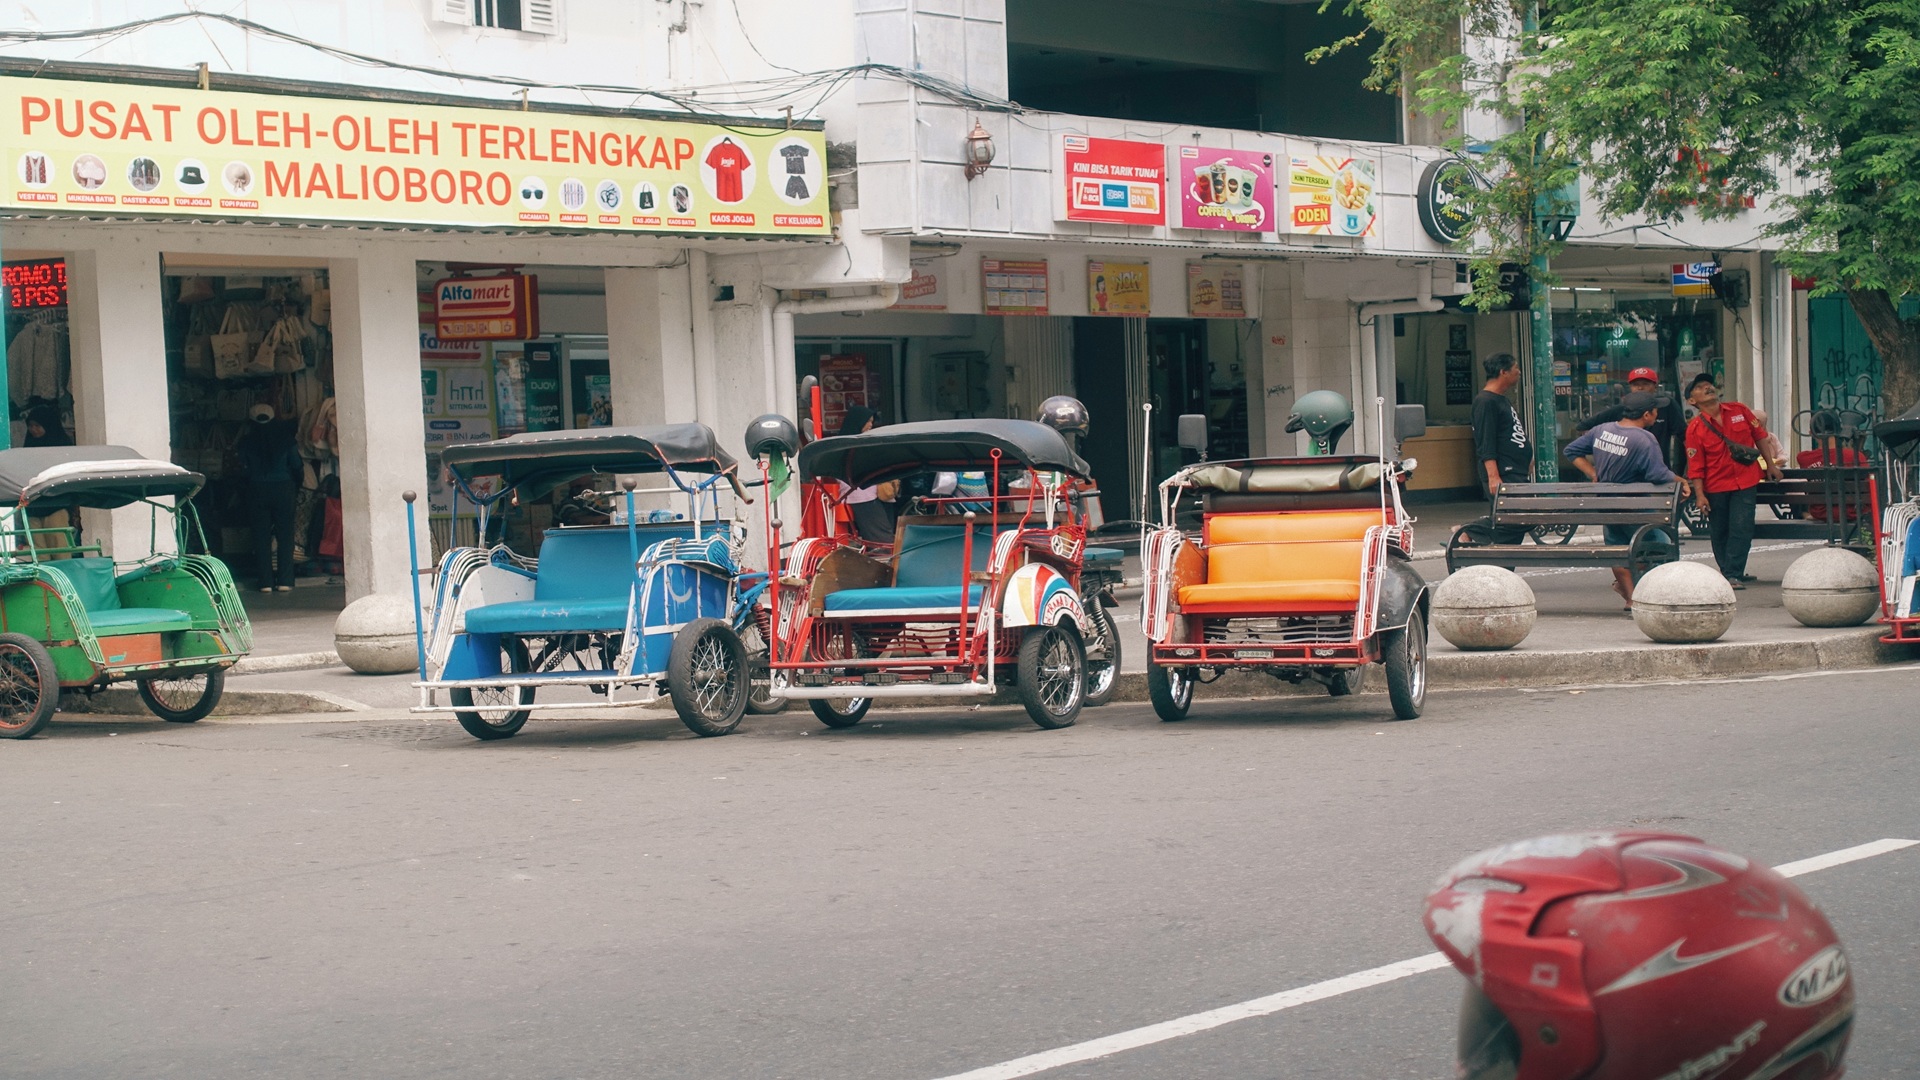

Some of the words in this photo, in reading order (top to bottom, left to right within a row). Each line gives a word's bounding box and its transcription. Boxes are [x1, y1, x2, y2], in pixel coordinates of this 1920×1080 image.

[21, 96, 181, 142] PUSAT
[197, 107, 439, 156] OLEH-OLEH
[451, 122, 695, 171] TERLENGKAP
[1073, 162, 1090, 173] KINI
[1091, 164, 1109, 175] BISA
[1111, 165, 1134, 177] TARIK
[1135, 168, 1159, 179] TUNAI
[265, 160, 512, 206] MALIOBORO
[1293, 174, 1306, 182] KINI
[1306, 176, 1330, 186] TERSEDIA
[19, 193, 35, 201] VEST
[37, 194, 57, 202] BATIK
[67, 194, 94, 203] MUKENA
[96, 195, 115, 204] BATIK
[176, 198, 190, 206] TOPI
[191, 199, 211, 207] JOGJA
[1131, 195, 1147, 206] BNI
[236, 201, 258, 209] PANTAI
[520, 213, 549, 221] KACAMATA
[561, 214, 572, 222] JAM
[712, 215, 730, 223] KAOS
[732, 215, 754, 224] JOGJA
[1198, 206, 1225, 218] COFFEE
[1226, 209, 1234, 222] &
[1297, 207, 1328, 223] ODEN
[775, 216, 787, 225] SET
[788, 216, 823, 226] KELUARGA
[2, 264, 52, 287] ROMO
[53, 262, 67, 283] T
[11, 287, 22, 307] 3
[25, 284, 60, 307] PCS
[441, 284, 511, 301] Alfamart
[903, 285, 936, 299] PRAKTIS
[420, 333, 480, 350] famart
[530, 381, 556, 390] DJOY
[453, 432, 468, 441] BNI
[1593, 437, 1629, 457] MALIOBORO
[431, 503, 448, 513] Spot
